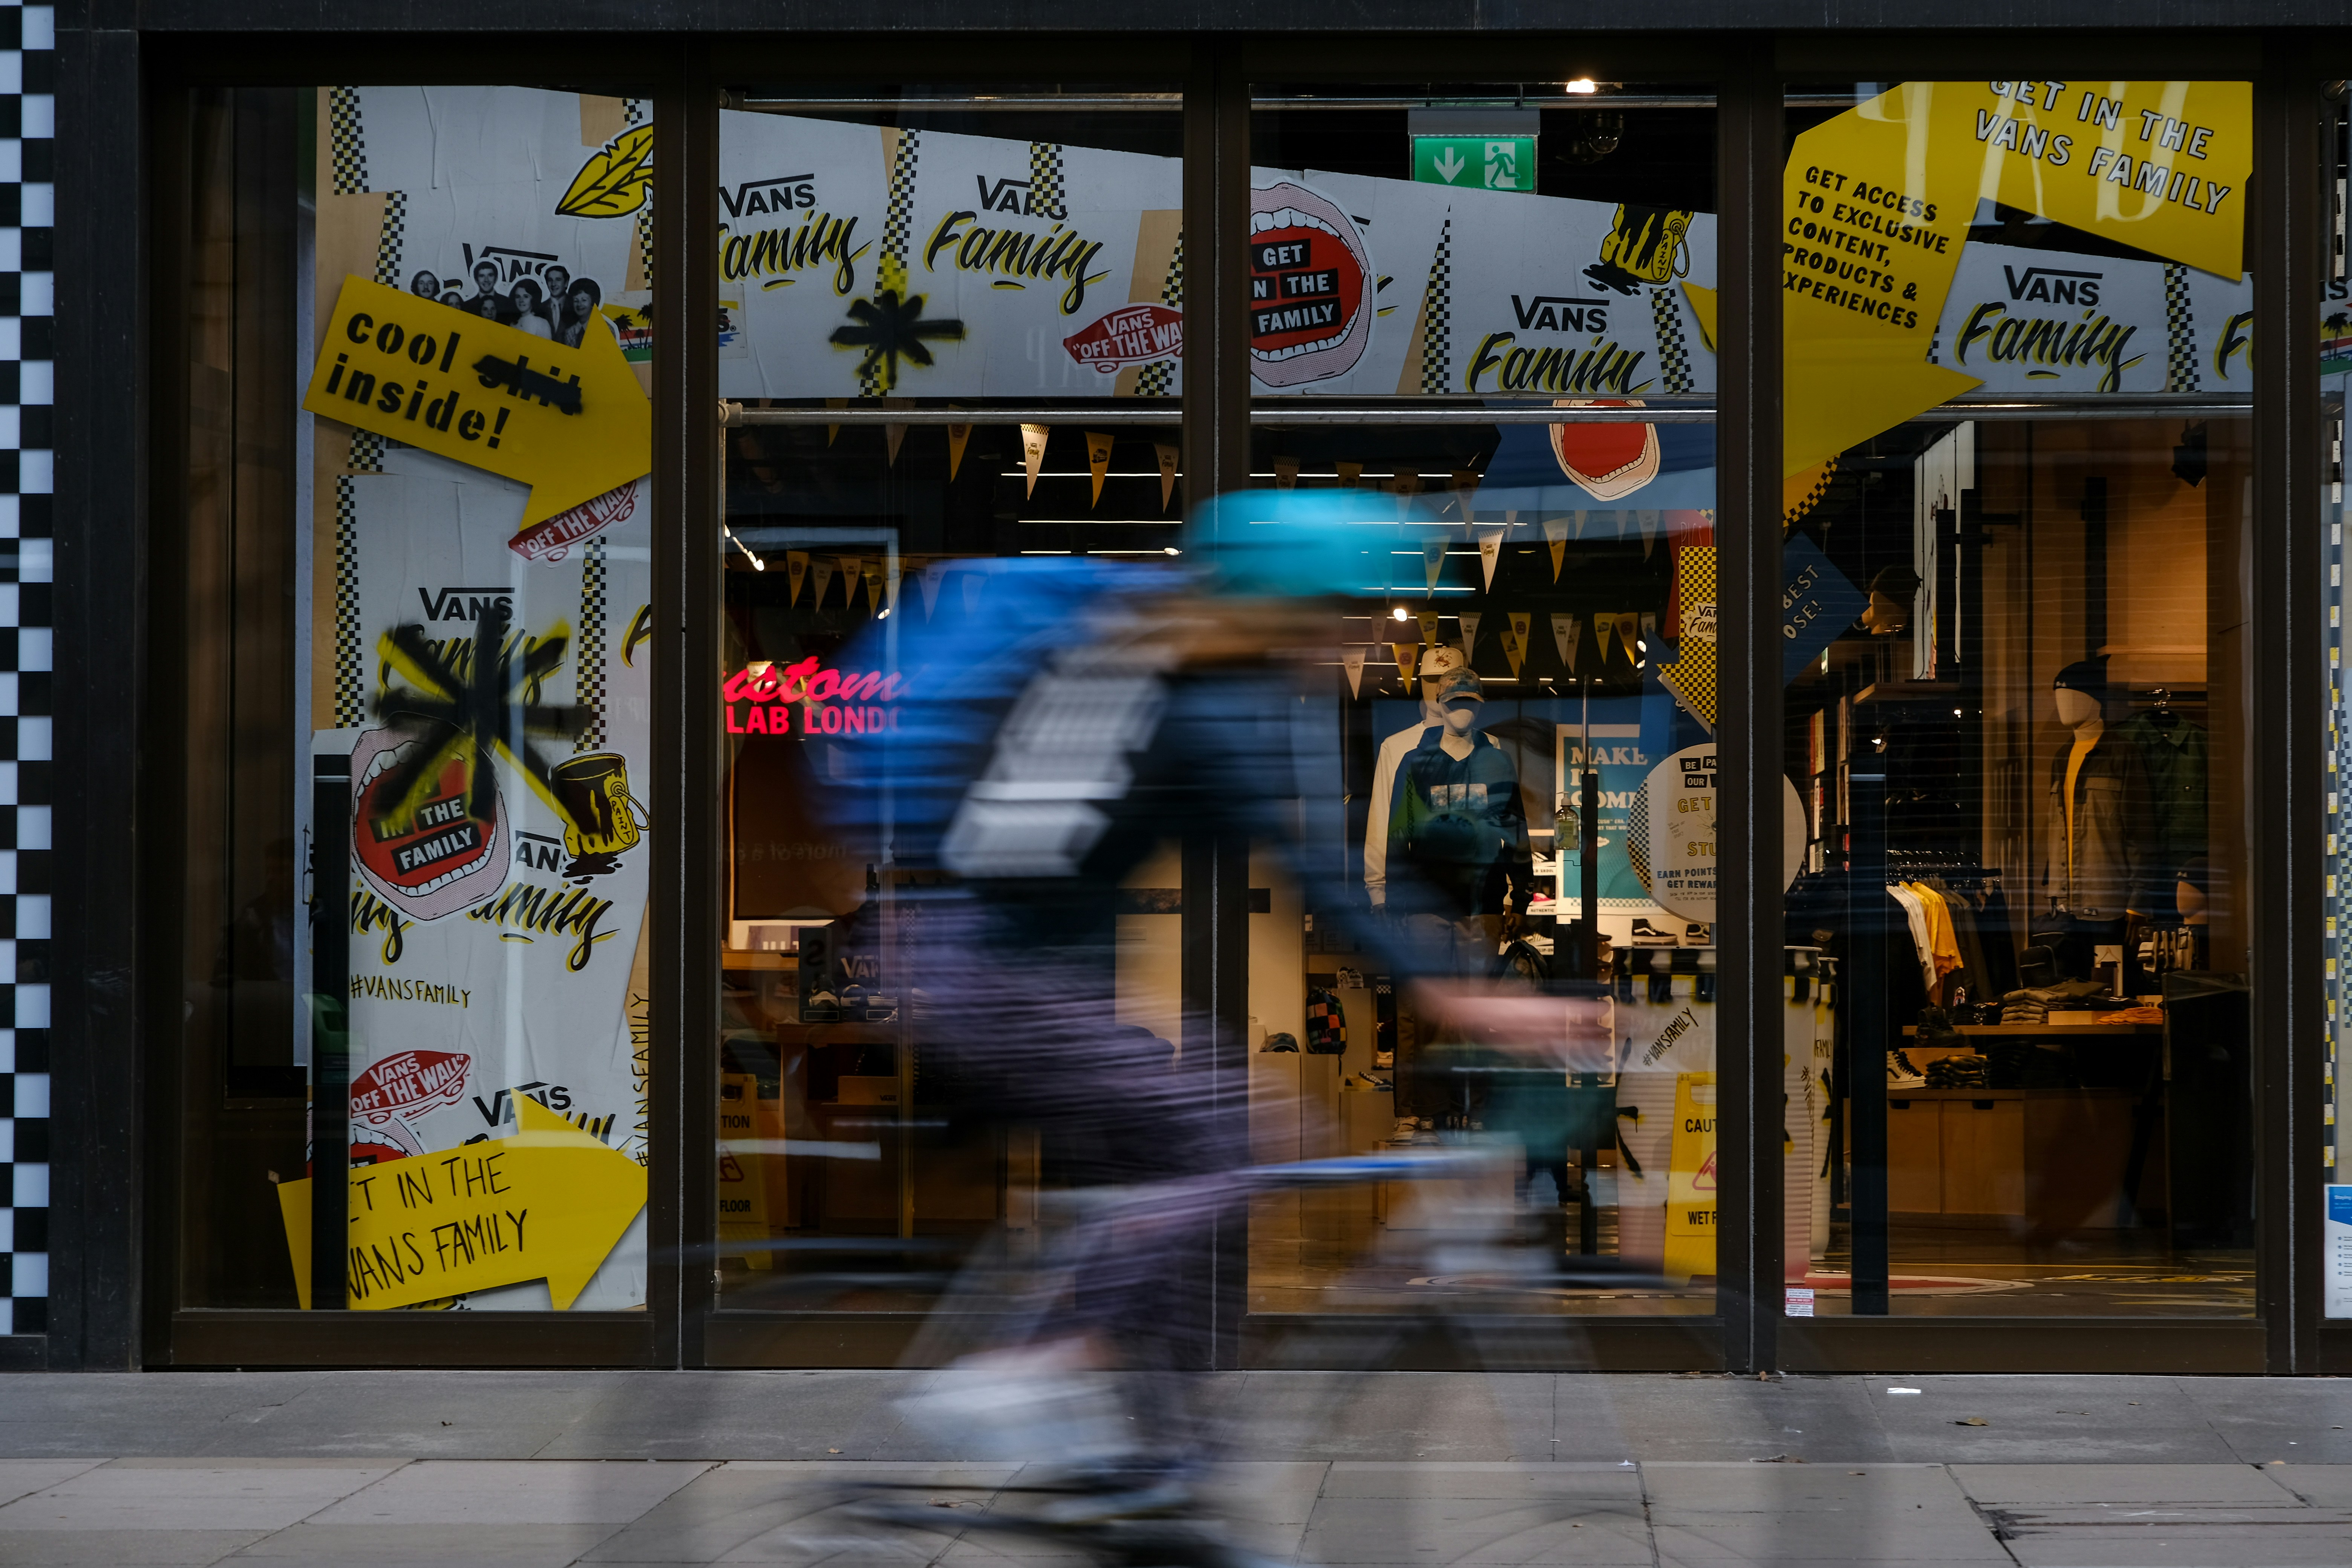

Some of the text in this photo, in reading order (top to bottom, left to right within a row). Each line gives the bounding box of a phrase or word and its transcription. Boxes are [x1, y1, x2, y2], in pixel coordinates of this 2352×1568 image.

[1989, 81, 2214, 159] GET IN THE
[1976, 109, 2231, 214] VANS FAMILY
[719, 173, 816, 218] VANS
[977, 174, 1067, 220] VA
[1805, 166, 1937, 221] GET ACCESS
[1798, 191, 1949, 254] TO EXCLUSIVE
[1263, 245, 1303, 266] GET
[1658, 233, 1669, 276] PAINT
[1788, 217, 1891, 267] CONTENT,
[924, 211, 1112, 315] Family
[1783, 243, 1917, 302] PRODUCTS &
[1254, 274, 1330, 298] N THE
[1783, 270, 1918, 329] XPERIENCES
[2003, 265, 2103, 307] VANS
[1102, 308, 1154, 336] VANS
[1258, 304, 1334, 333] FAMILY
[1511, 295, 1610, 333] VANS
[347, 313, 461, 373] cool
[1113, 329, 1152, 356] THE
[1150, 320, 1183, 351] WA
[1959, 301, 2148, 392] Family
[1468, 332, 1657, 394] Family
[326, 353, 510, 449] inside!
[553, 507, 594, 539] THE
[418, 587, 515, 621] VANS
[1783, 564, 1819, 610] BEST
[1690, 617, 1717, 634] Fam
[1698, 605, 1717, 617] VA
[1783, 599, 1823, 639] OSE!
[723, 656, 906, 703] ustom
[726, 706, 790, 734] LAB
[1571, 747, 1648, 765] MAKE
[1687, 778, 1704, 786] OUR
[420, 799, 464, 825] THE
[612, 801, 631, 839] PAINT
[1678, 797, 1711, 813] GET
[399, 827, 472, 870] FAMILY
[515, 830, 567, 872] AN
[1687, 842, 1717, 856] STU
[1657, 867, 1717, 879] EARN POINTS
[841, 955, 879, 978] VAN
[351, 974, 471, 1008] #VANSFAMILY
[1643, 1007, 1699, 1067] #VANSFAMILY
[368, 1052, 420, 1086] VANS
[351, 1089, 380, 1112] OFF
[381, 1074, 421, 1105] THE
[721, 1115, 750, 1129] TION
[1686, 1119, 1717, 1133] CAUT
[397, 1167, 433, 1208] IN
[441, 1152, 511, 1198] THE
[720, 1200, 751, 1212] FLOOR
[1688, 1211, 1709, 1225] WET
[431, 1209, 528, 1272] FAMILY
